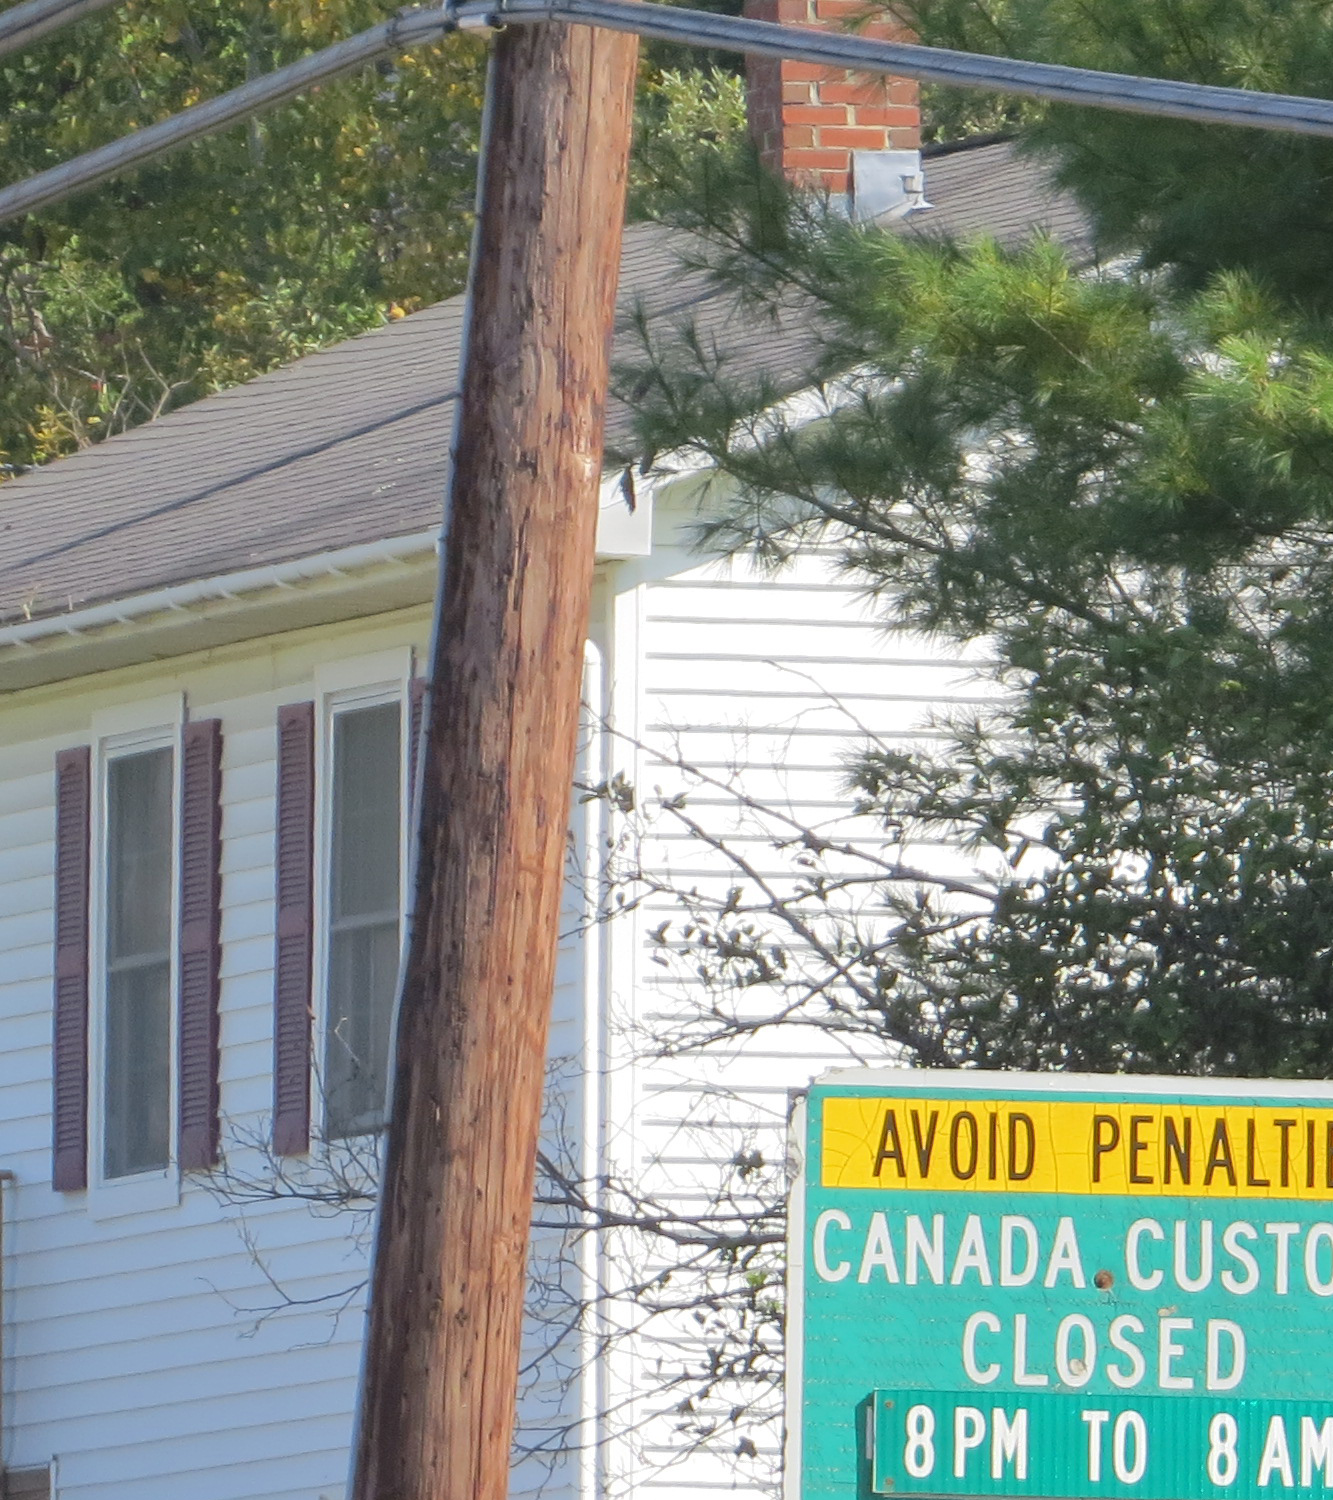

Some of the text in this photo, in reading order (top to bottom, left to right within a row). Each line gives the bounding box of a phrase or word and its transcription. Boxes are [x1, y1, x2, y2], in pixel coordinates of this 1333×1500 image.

[874, 1109, 1036, 1181] AVOID
[813, 1209, 1086, 1289] CANADA
[963, 1311, 1247, 1391] CLOSED
[1082, 1410, 1148, 1484] TO
